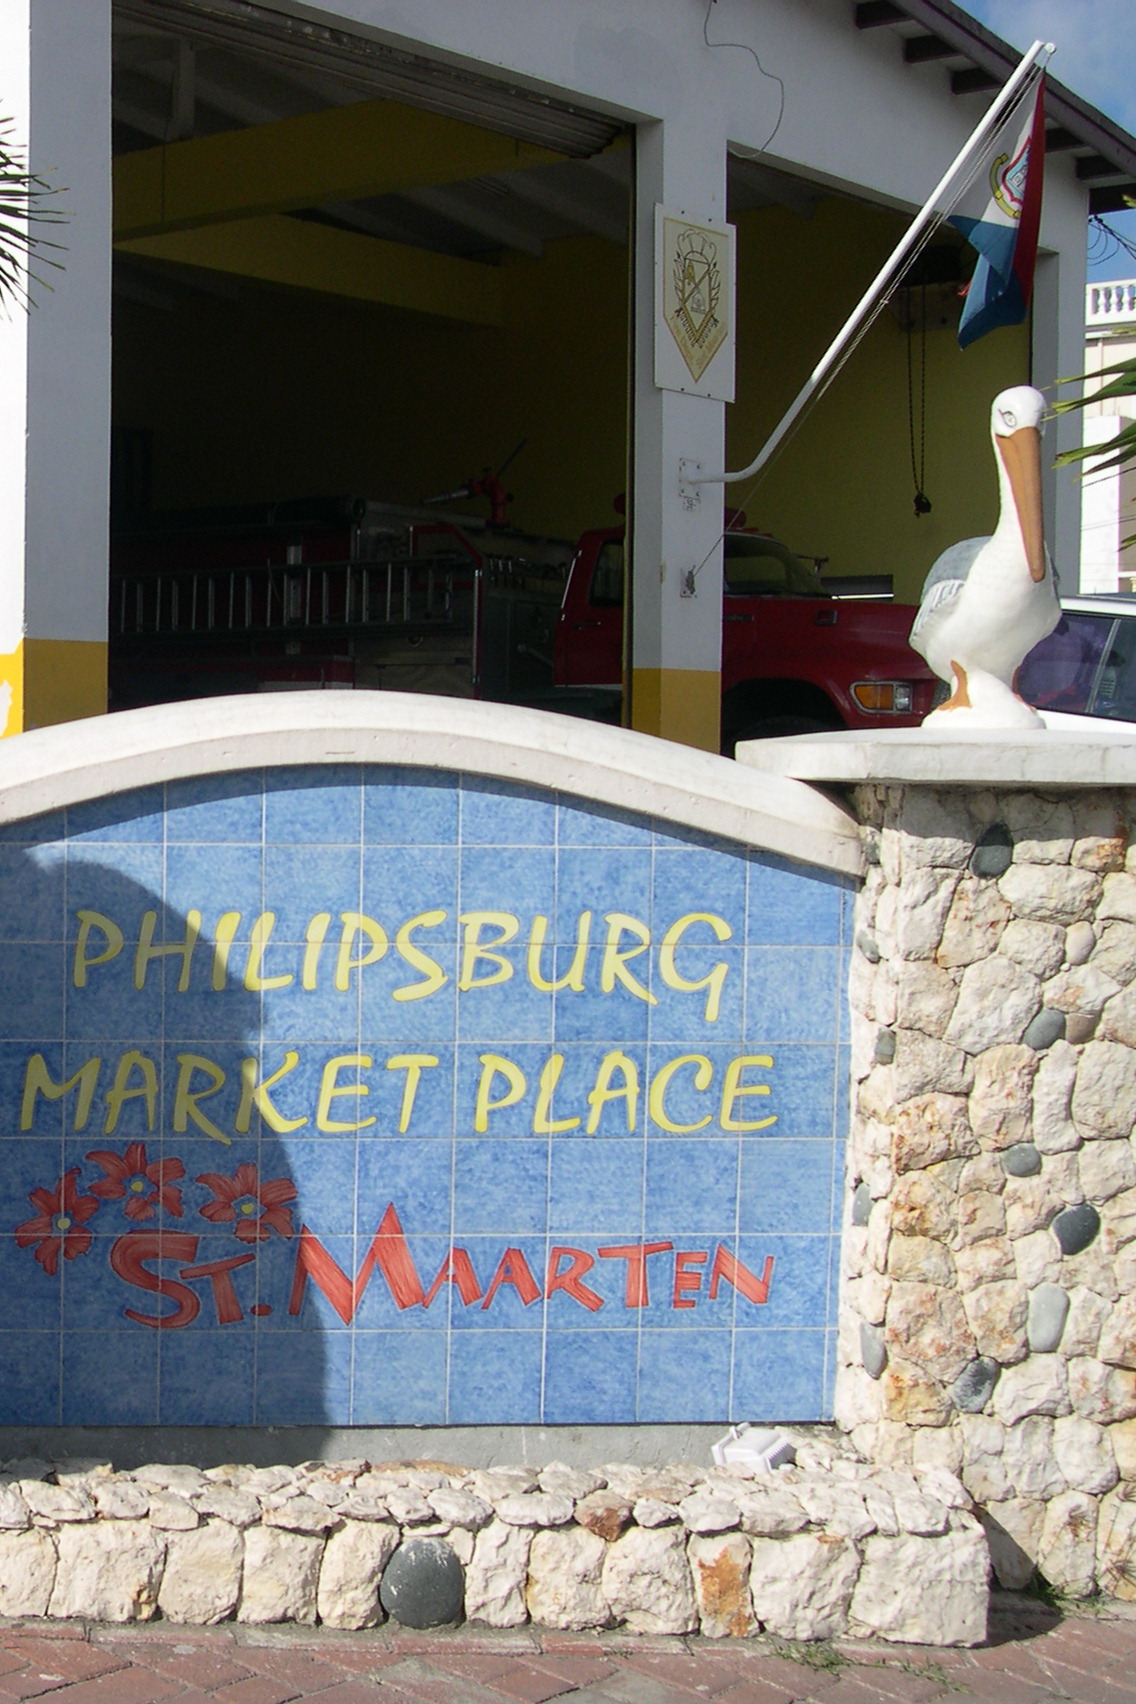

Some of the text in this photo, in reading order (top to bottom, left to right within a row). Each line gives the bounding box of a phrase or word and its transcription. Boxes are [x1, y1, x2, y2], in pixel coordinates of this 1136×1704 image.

[73, 910, 732, 1022] PHILIPSBURG
[20, 1050, 779, 1145] MARKET PLACE
